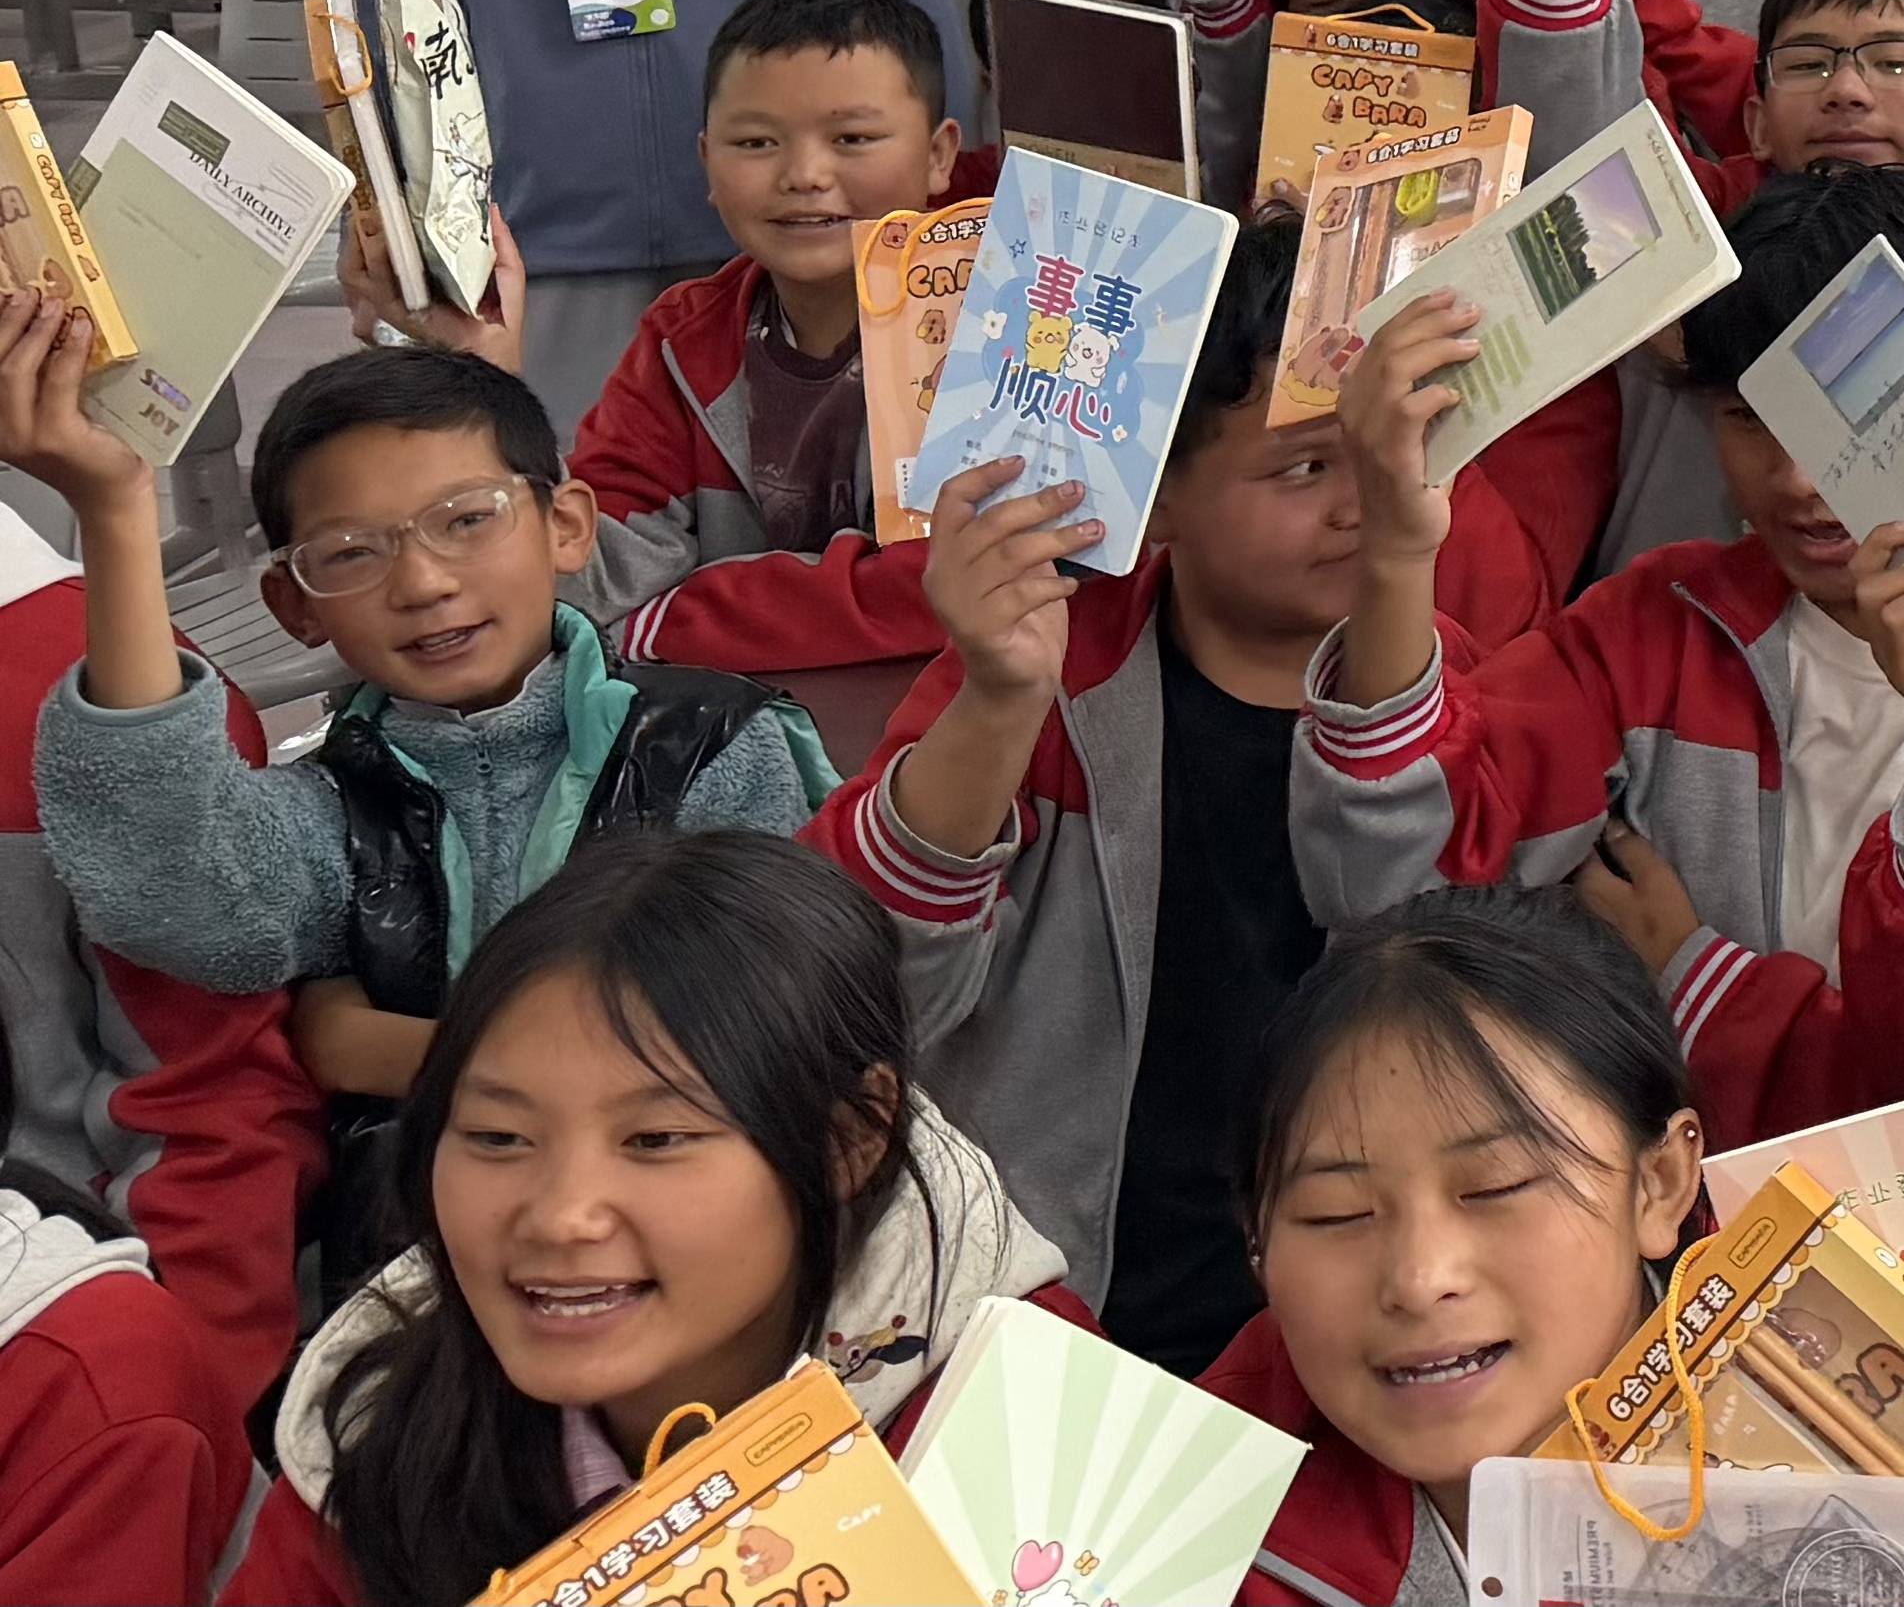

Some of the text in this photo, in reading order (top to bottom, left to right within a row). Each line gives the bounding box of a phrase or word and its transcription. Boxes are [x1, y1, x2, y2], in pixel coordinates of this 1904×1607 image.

[1312, 64, 1393, 97] CAPY
[1353, 97, 1427, 128] BARA
[189, 151, 297, 242] DAILY ARCHIVE
[1026, 253, 1143, 338] 事事
[988, 356, 1113, 440] 顺心
[1605, 1273, 1737, 1423] 6合1学习套装
